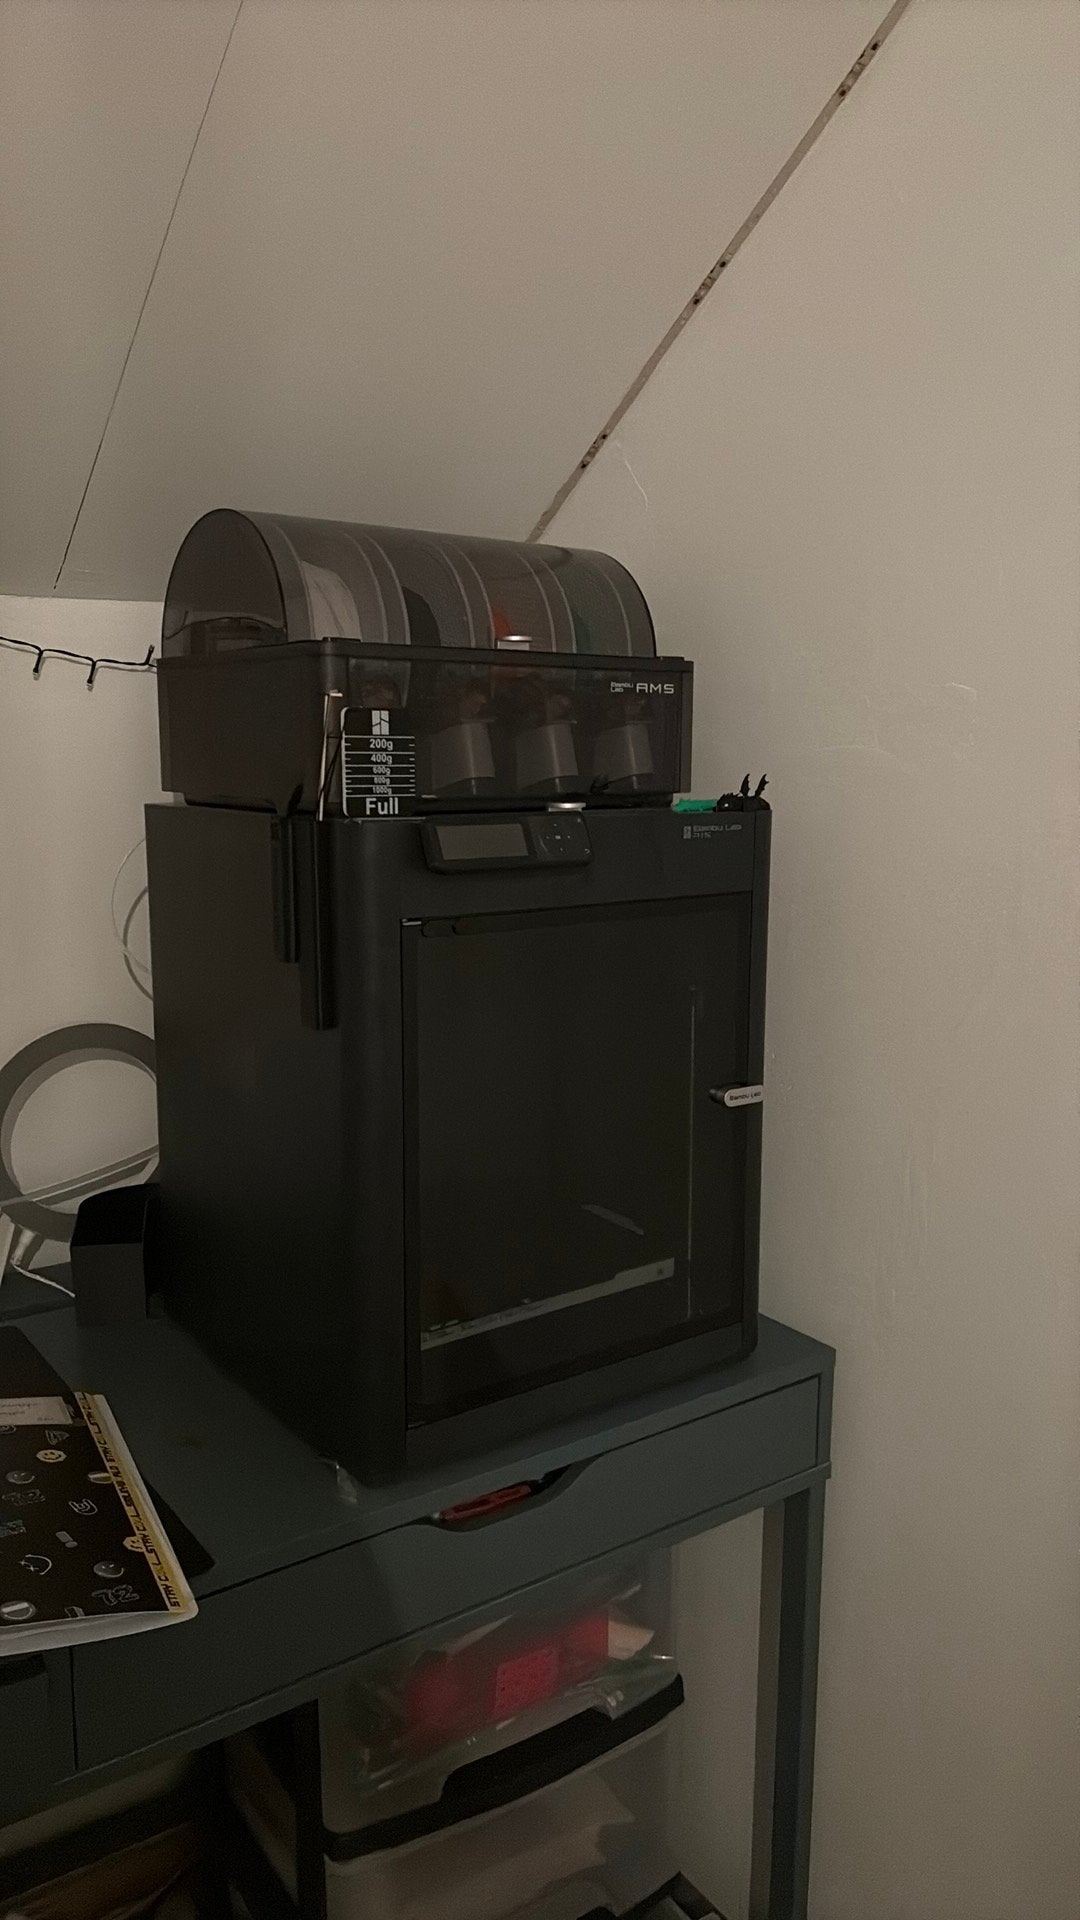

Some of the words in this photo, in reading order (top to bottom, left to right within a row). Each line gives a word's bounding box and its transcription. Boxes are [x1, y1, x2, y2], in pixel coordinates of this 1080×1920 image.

[636, 682, 675, 695] AMS
[369, 738, 394, 751] 200g
[370, 754, 393, 765] 400g
[372, 786, 392, 795] 1000g
[365, 797, 399, 815] Full
[141, 1532, 157, 1553] STAY
[161, 1584, 181, 1608] STAY
